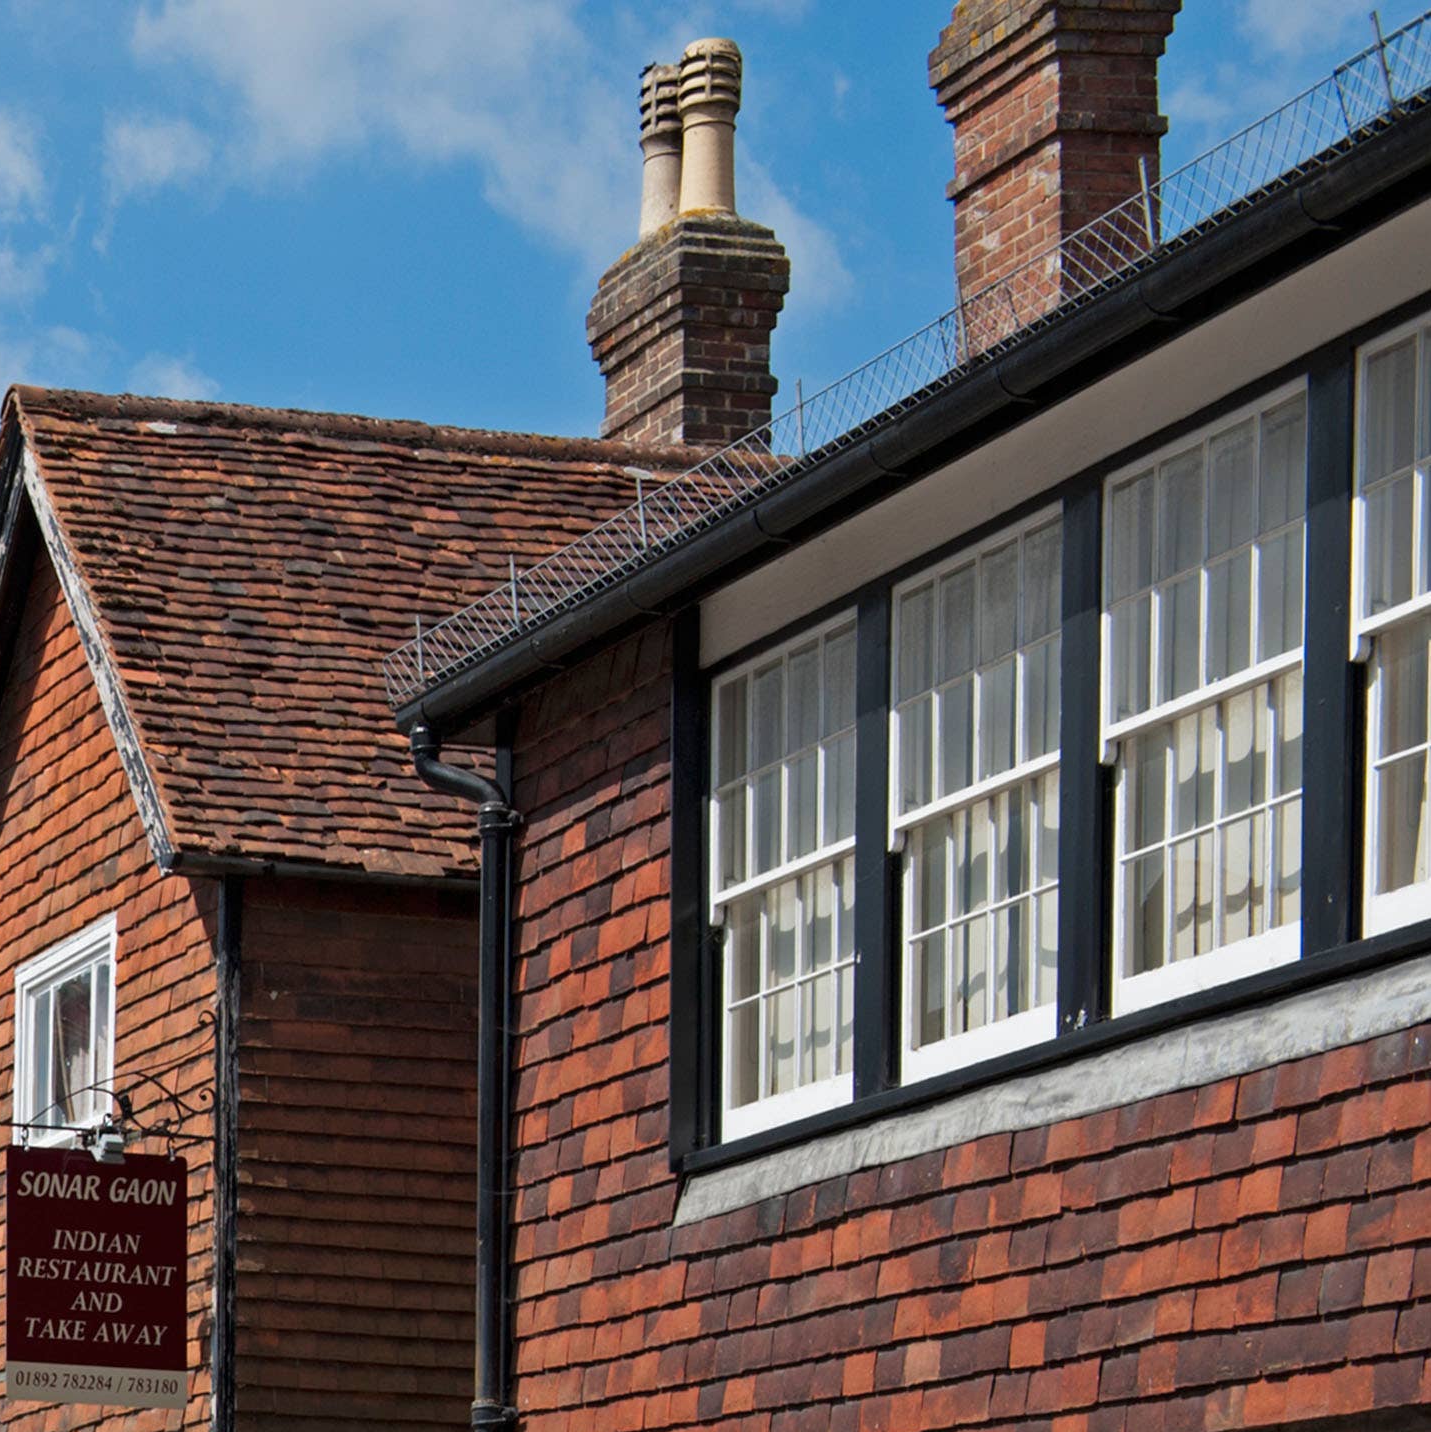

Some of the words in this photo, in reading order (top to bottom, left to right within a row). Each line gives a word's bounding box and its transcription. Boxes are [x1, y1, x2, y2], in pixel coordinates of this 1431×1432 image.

[17, 1171, 101, 1201] SONAR
[109, 1177, 177, 1206] GAON
[53, 1229, 141, 1254] INDIAN
[17, 1257, 177, 1286] RESTAURANT
[70, 1291, 123, 1313] AND
[25, 1317, 86, 1341] TAKE
[93, 1322, 167, 1346] AWAY
[15, 1370, 58, 1388] 01892
[63, 1373, 112, 1391] 782284
[116, 1376, 124, 1393] /
[127, 1377, 178, 1395] 783180
